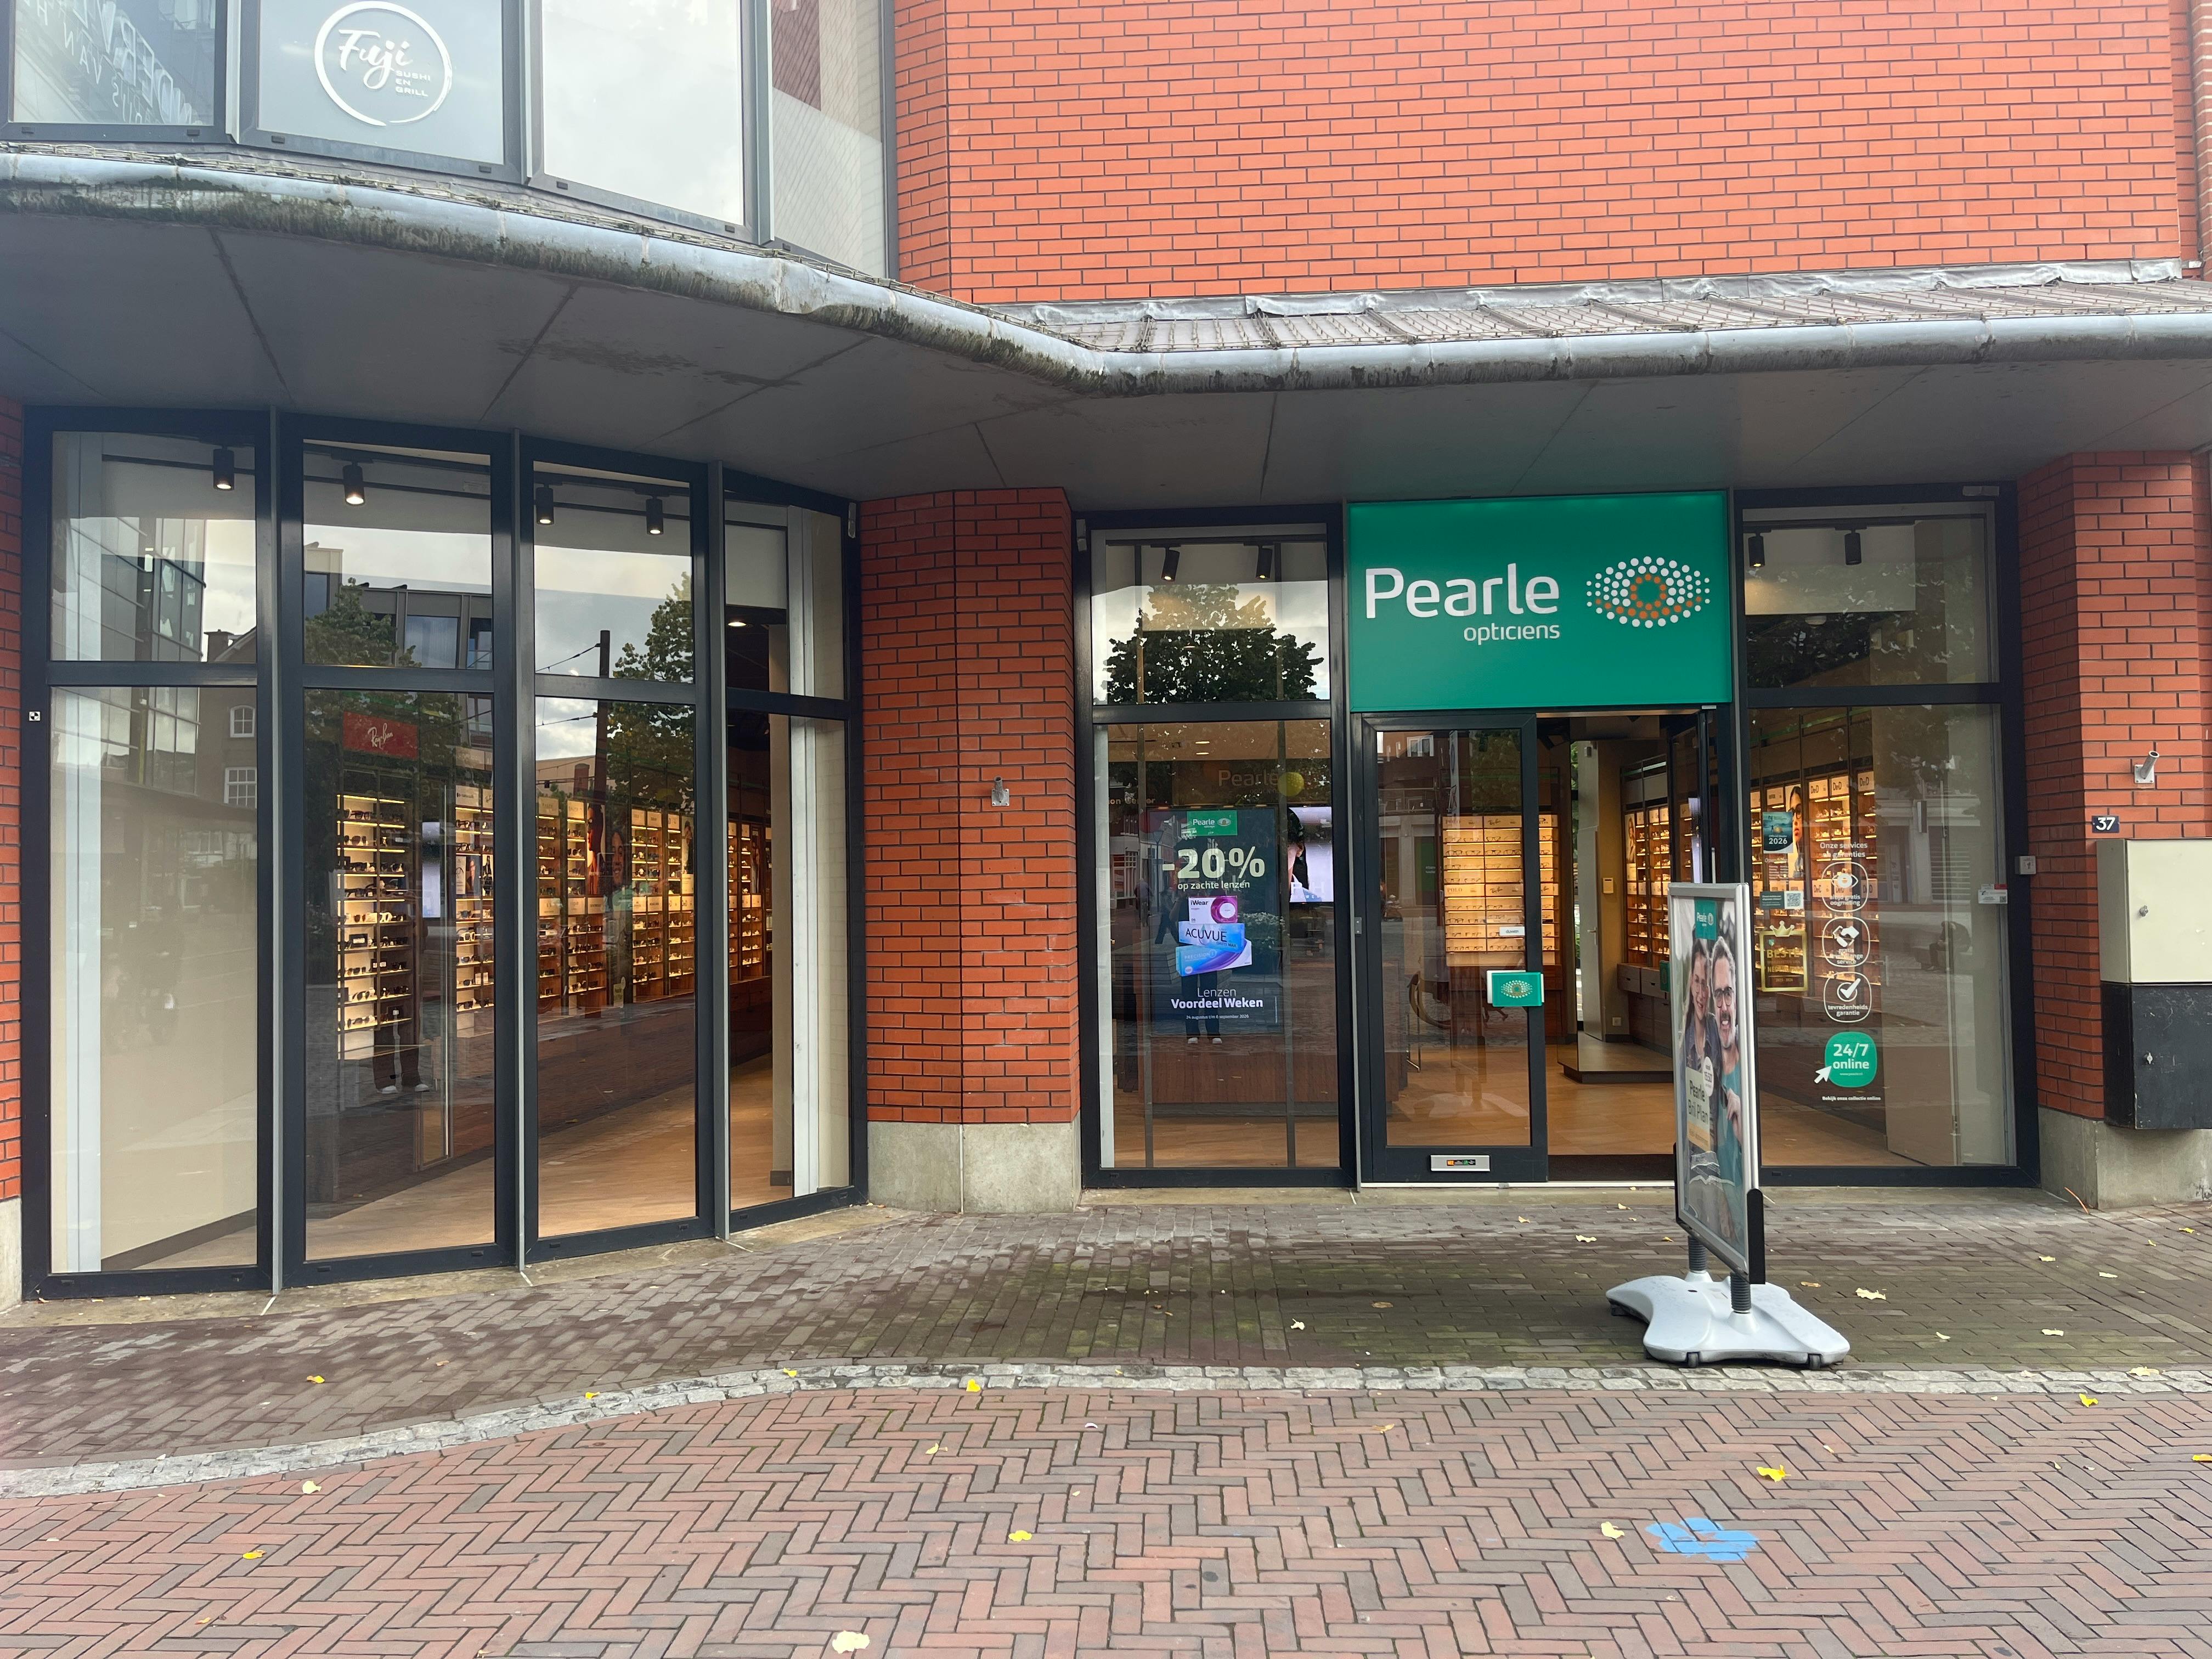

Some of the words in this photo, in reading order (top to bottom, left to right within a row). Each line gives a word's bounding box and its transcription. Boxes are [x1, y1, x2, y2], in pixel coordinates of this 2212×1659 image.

[338, 29, 414, 89] Fuji
[396, 70, 431, 81] SUSHI
[396, 87, 428, 97] GRILL
[1365, 563, 1559, 619] Pearle
[1464, 622, 1560, 646] opticiens
[1218, 770, 1278, 787] Pearle
[2096, 817, 2115, 831] 37
[1163, 847, 1265, 878] -20%
[1178, 883, 1189, 891] op
[1221, 881, 1250, 889] lenzen
[1186, 928, 1227, 942] ACUVUE
[1197, 988, 1237, 997] Lenzen
[1171, 997, 1222, 1009] Voordeel
[1223, 997, 1263, 1008] Weken
[1833, 1042, 1869, 1058] 24/7
[1832, 1058, 1870, 1069] online
[1689, 1079, 1706, 1102] Pearle
